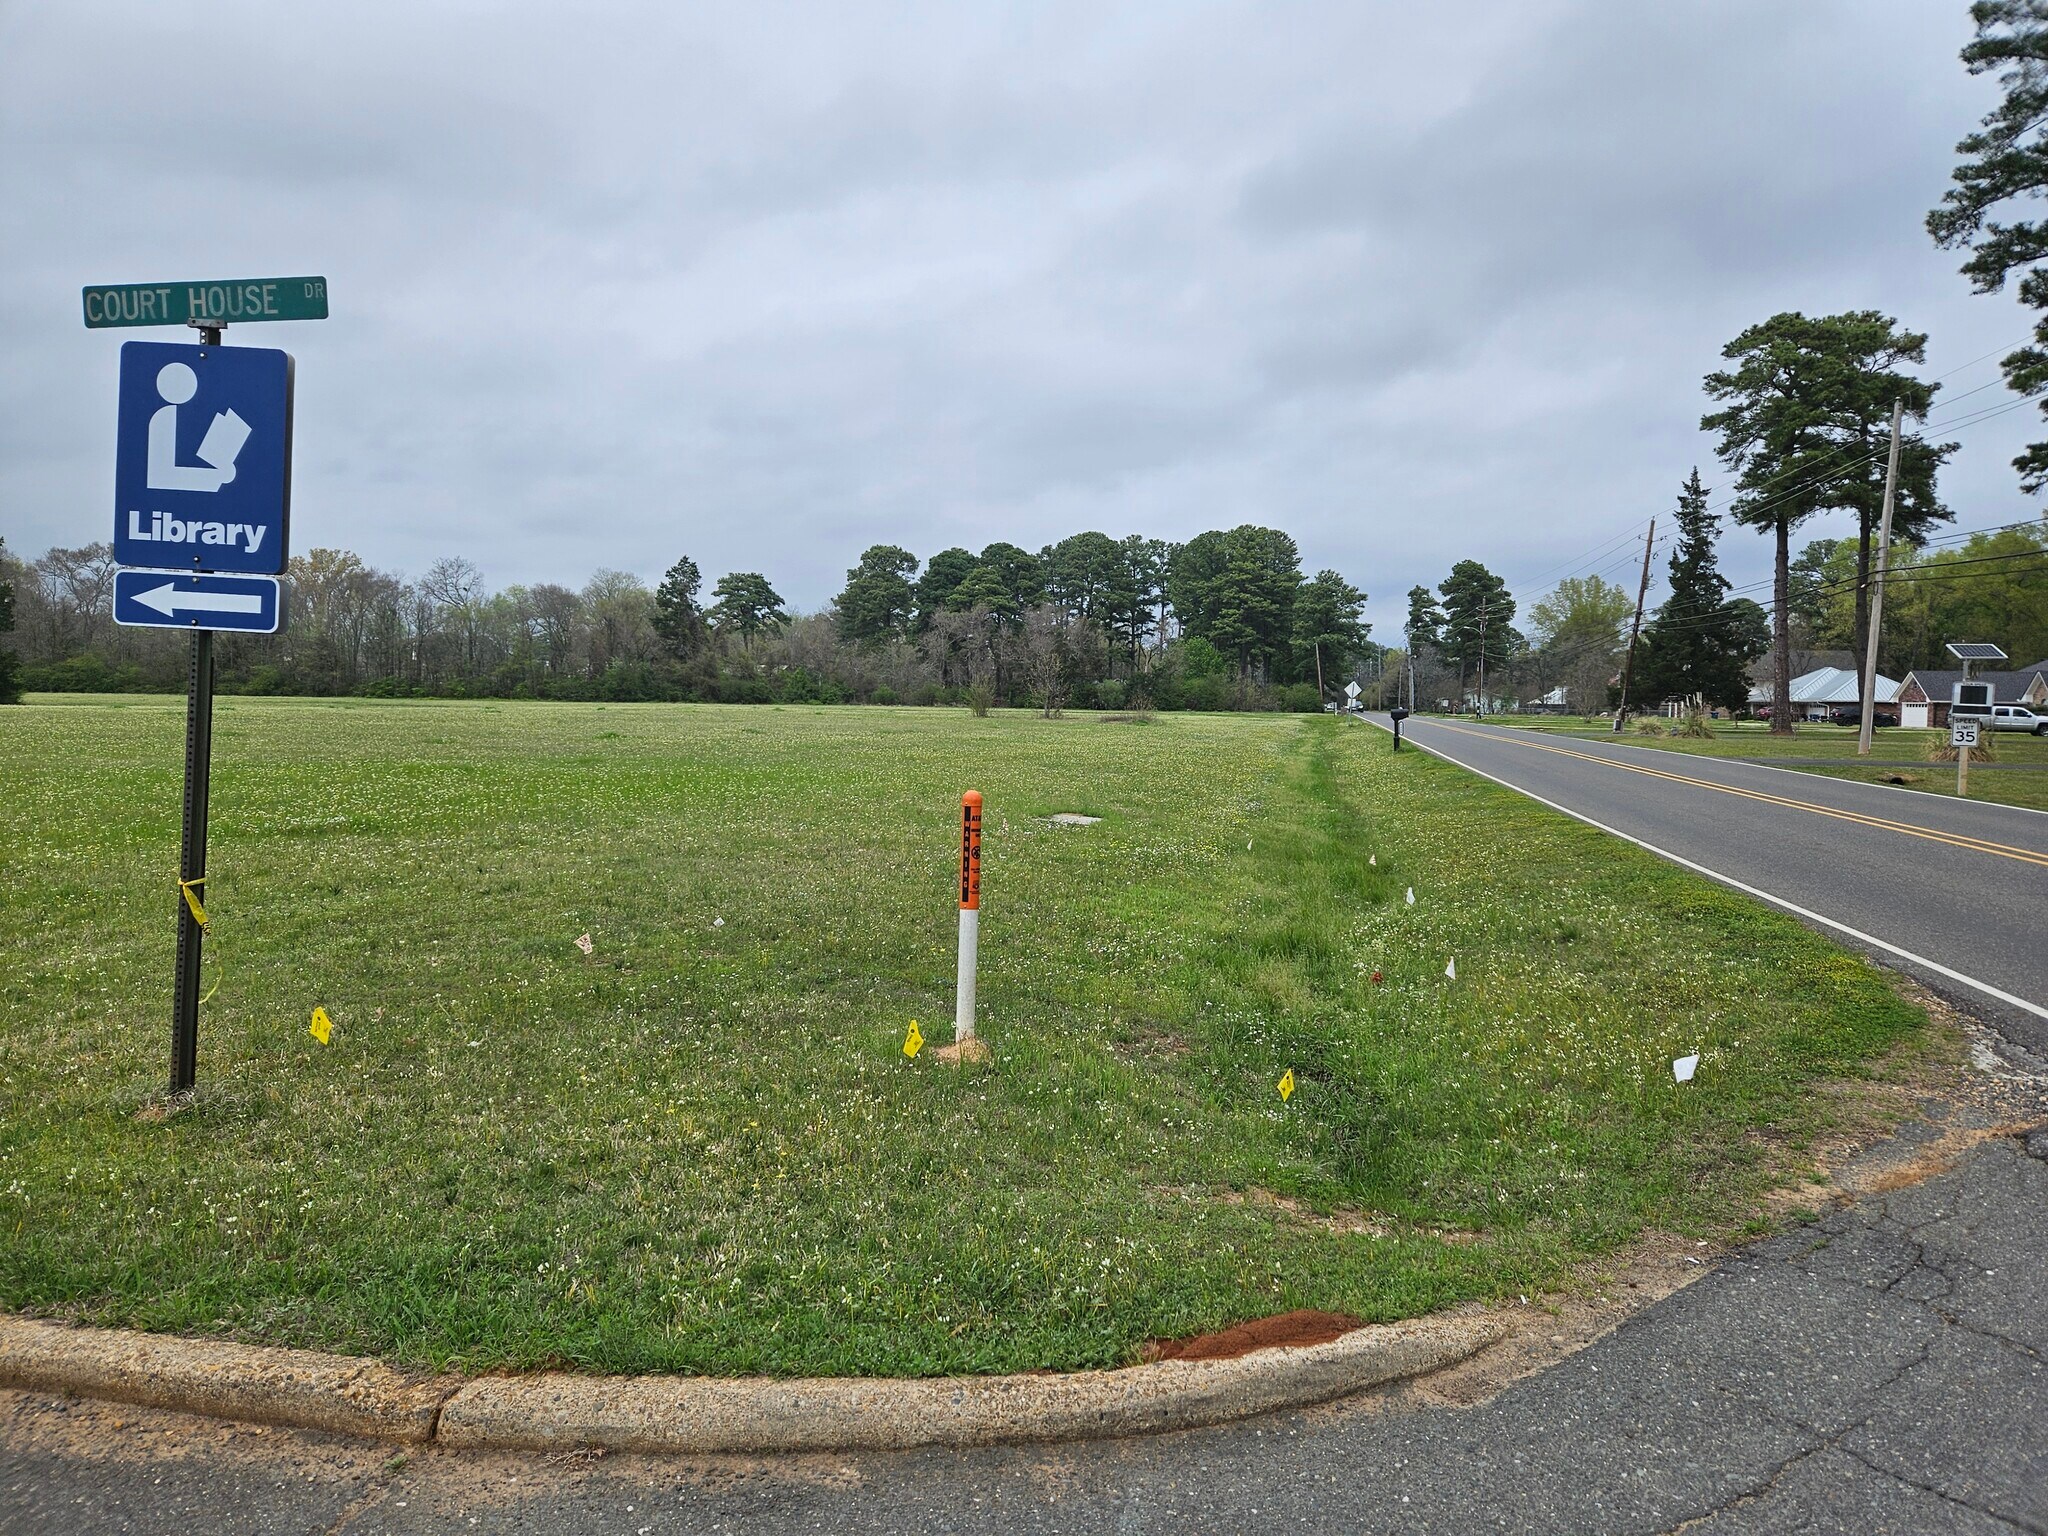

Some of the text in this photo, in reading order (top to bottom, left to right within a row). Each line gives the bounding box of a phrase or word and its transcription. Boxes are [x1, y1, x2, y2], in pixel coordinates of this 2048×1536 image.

[86, 283, 324, 321] COURT HOUSE DR
[128, 510, 267, 553] Library
[1955, 731, 1975, 742] 35
